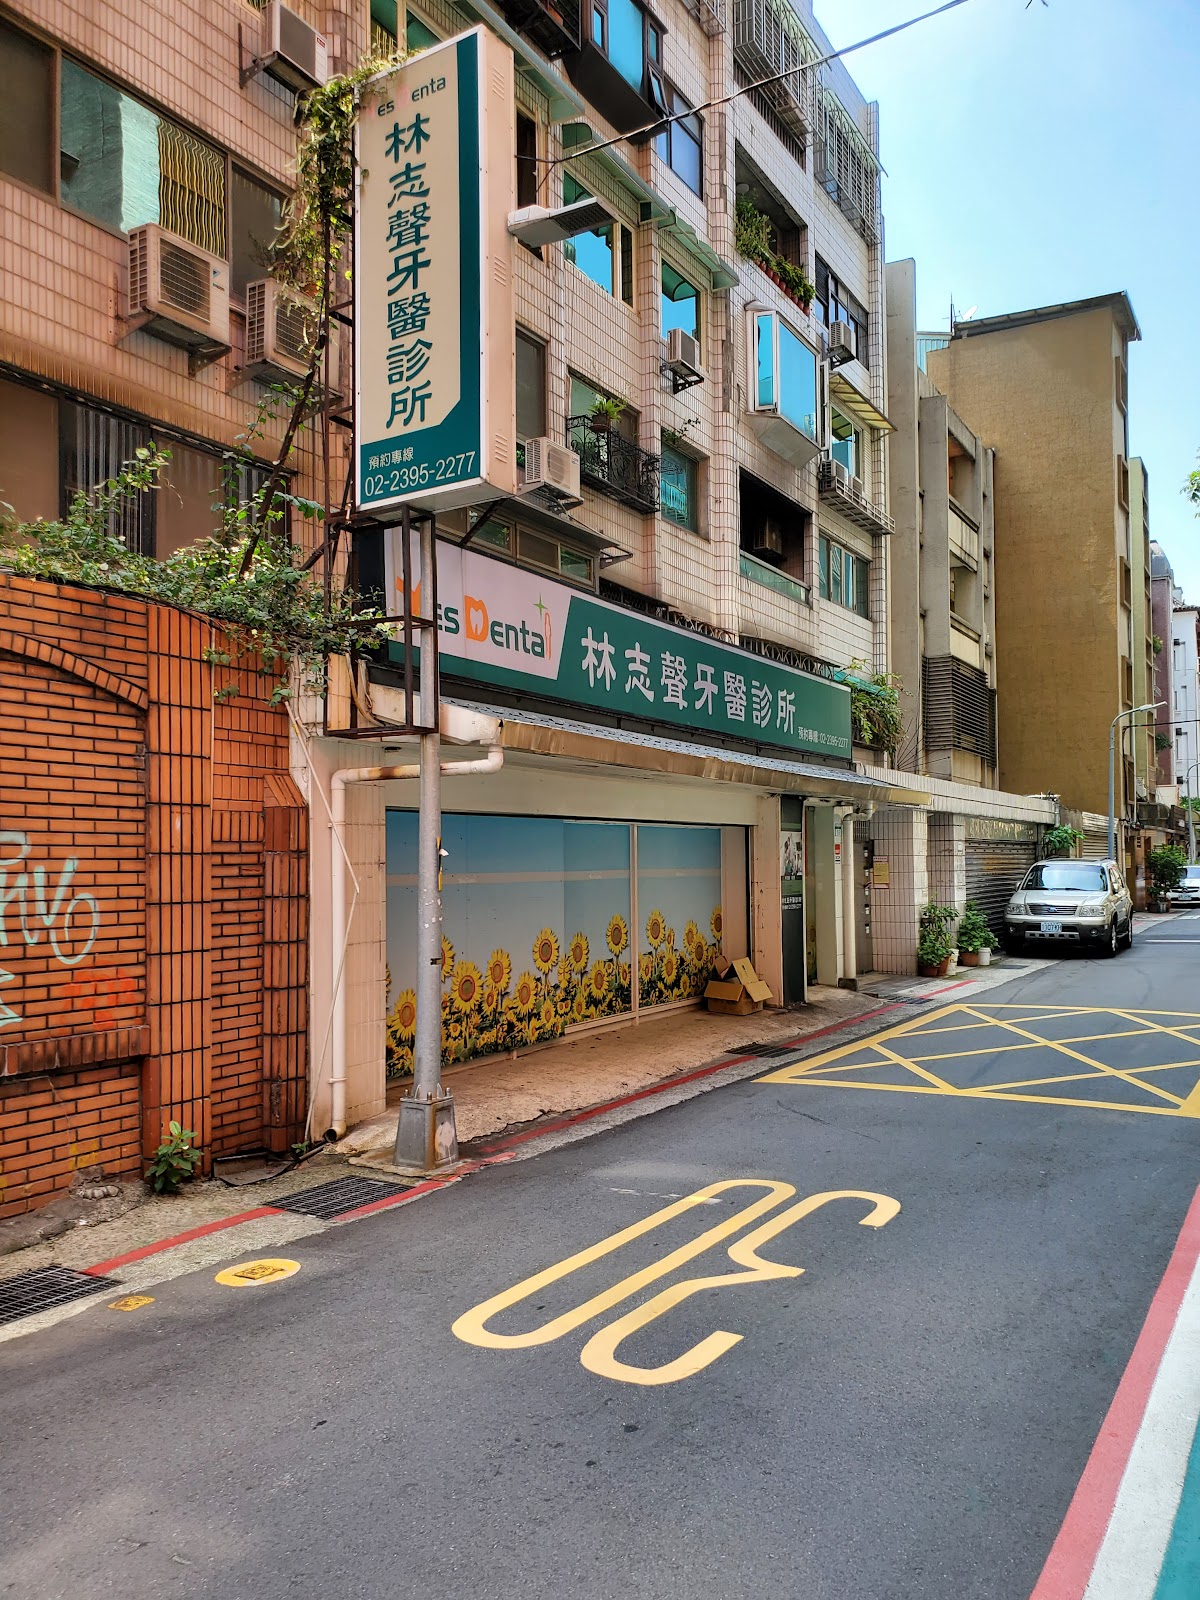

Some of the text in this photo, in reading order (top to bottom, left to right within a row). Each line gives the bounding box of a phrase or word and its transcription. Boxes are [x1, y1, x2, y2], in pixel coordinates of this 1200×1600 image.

[384, 112, 432, 429] 林志聲牙醫診所
[364, 450, 477, 497] 02-2395-2277
[368, 446, 414, 471] 預約專線
[580, 626, 796, 735] 林志聲牙醫診所
[451, 1179, 901, 1385] 30
